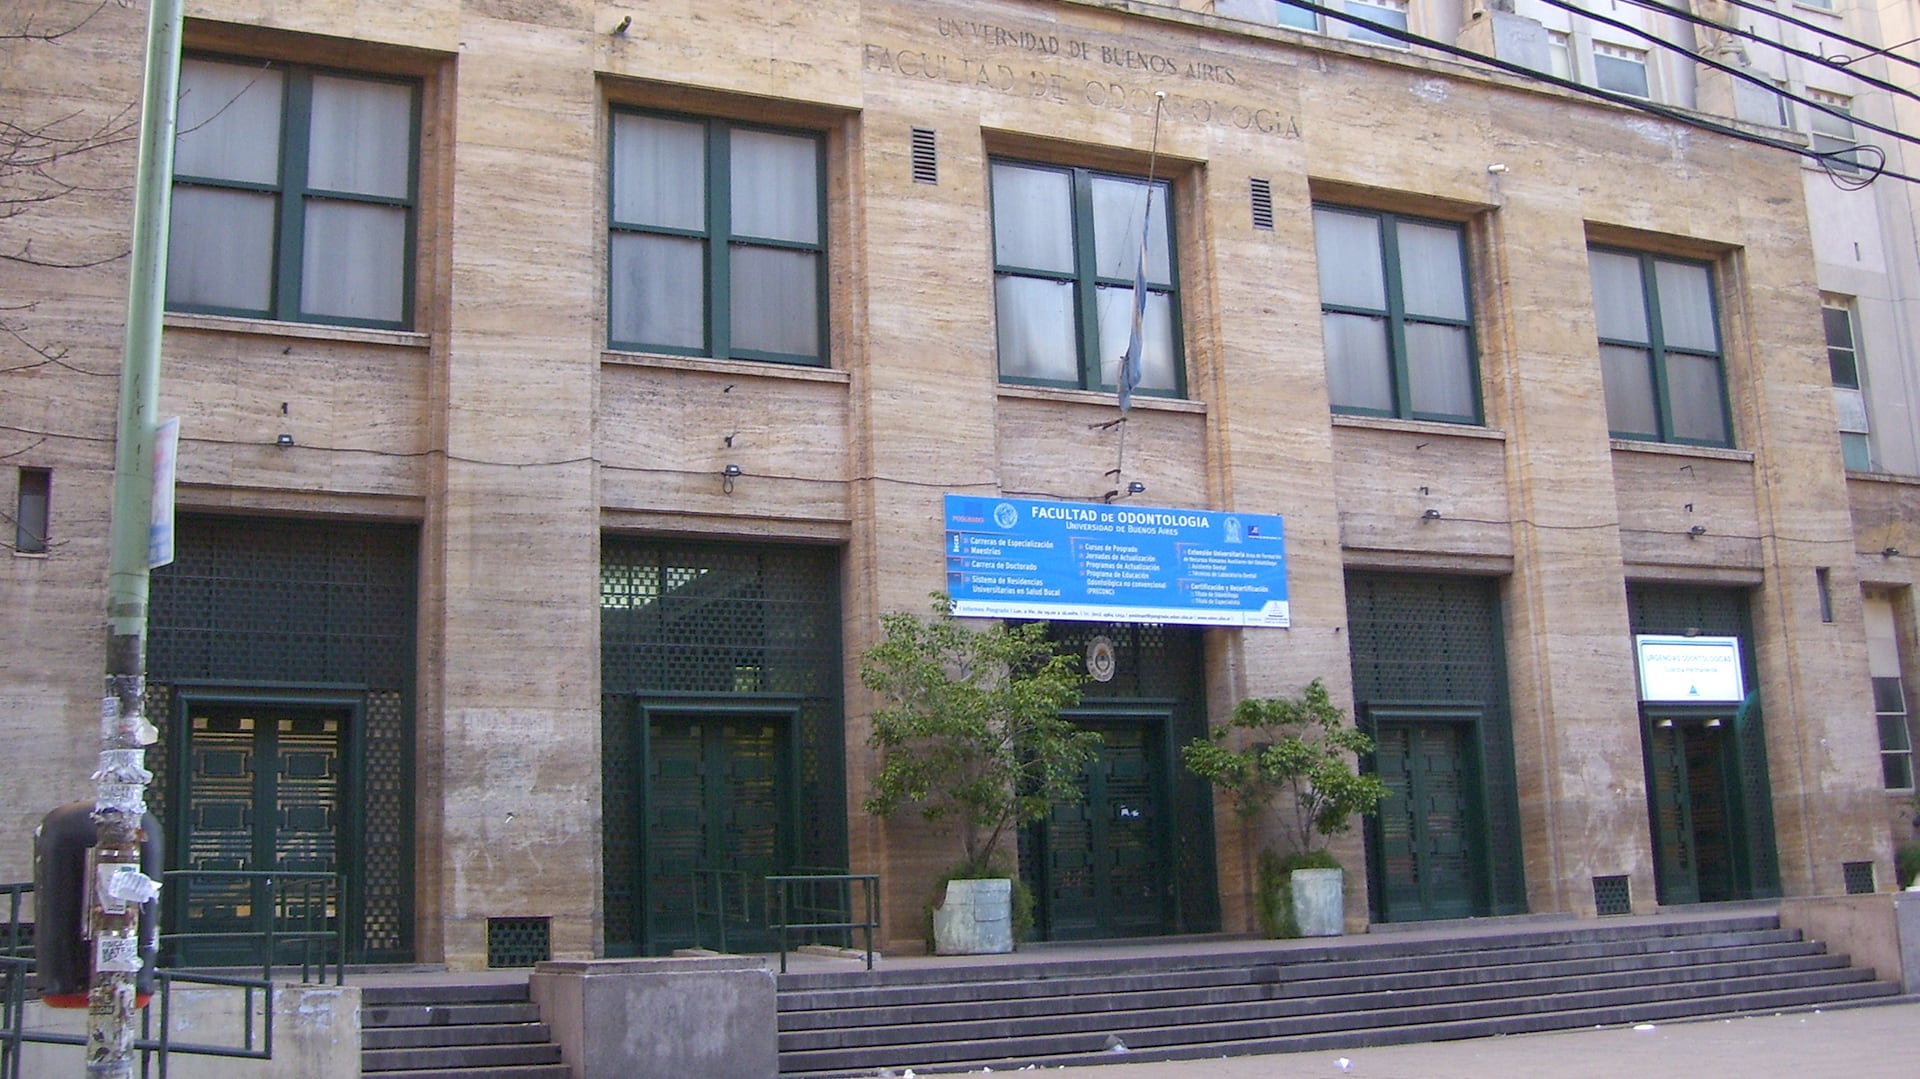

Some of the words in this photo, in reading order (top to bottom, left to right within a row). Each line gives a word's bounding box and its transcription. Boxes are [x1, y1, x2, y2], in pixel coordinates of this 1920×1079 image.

[937, 17, 1059, 55] UNIVERSIDAD
[1069, 40, 1089, 60] DE
[1101, 45, 1178, 75] BUENOS
[1186, 62, 1237, 85] AIRES
[864, 43, 1015, 91] FACULTAD
[1030, 70, 1071, 100] DE
[1032, 506, 1097, 521] FACULTAD
[1101, 513, 1114, 522] DE
[1118, 511, 1210, 528] ODONTOLOGIA
[1066, 521, 1114, 532] UNIVERSIDAD
[1128, 525, 1156, 535] BUENOS
[1158, 527, 1178, 536] AIRES
[970, 537, 997, 546] Carreras
[998, 538, 1006, 546] de
[972, 560, 995, 568] Carrera
[996, 561, 1004, 569] de
[1006, 562, 1038, 570] Doctorado
[972, 576, 996, 584] Sistema
[1006, 577, 1043, 586] Residencias
[1026, 588, 1042, 596] Salud
[1044, 588, 1061, 596] Bucal
